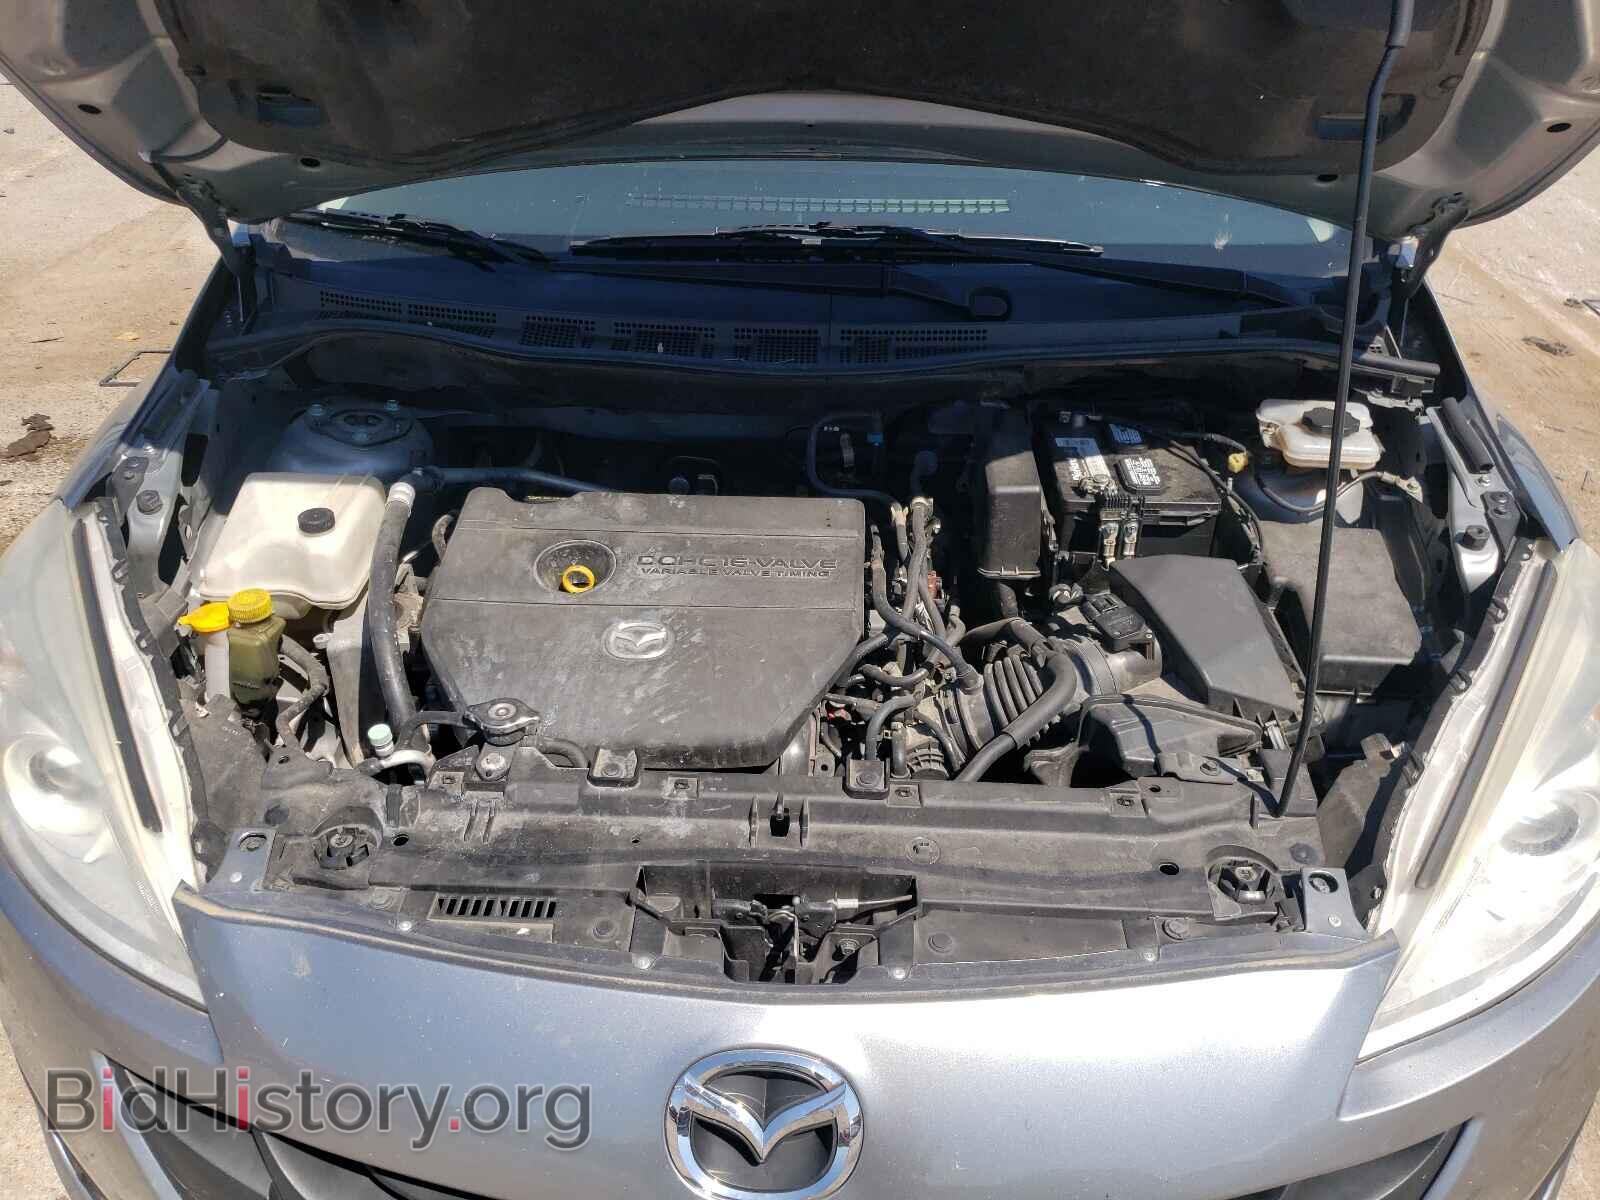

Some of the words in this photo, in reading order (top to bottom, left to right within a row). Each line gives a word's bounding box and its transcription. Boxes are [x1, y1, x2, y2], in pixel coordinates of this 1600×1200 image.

[722, 558, 838, 570] 16-VALVE
[641, 567, 718, 576] VARIABLE
[721, 569, 770, 577] VALVE
[775, 570, 831, 578] TIMING
